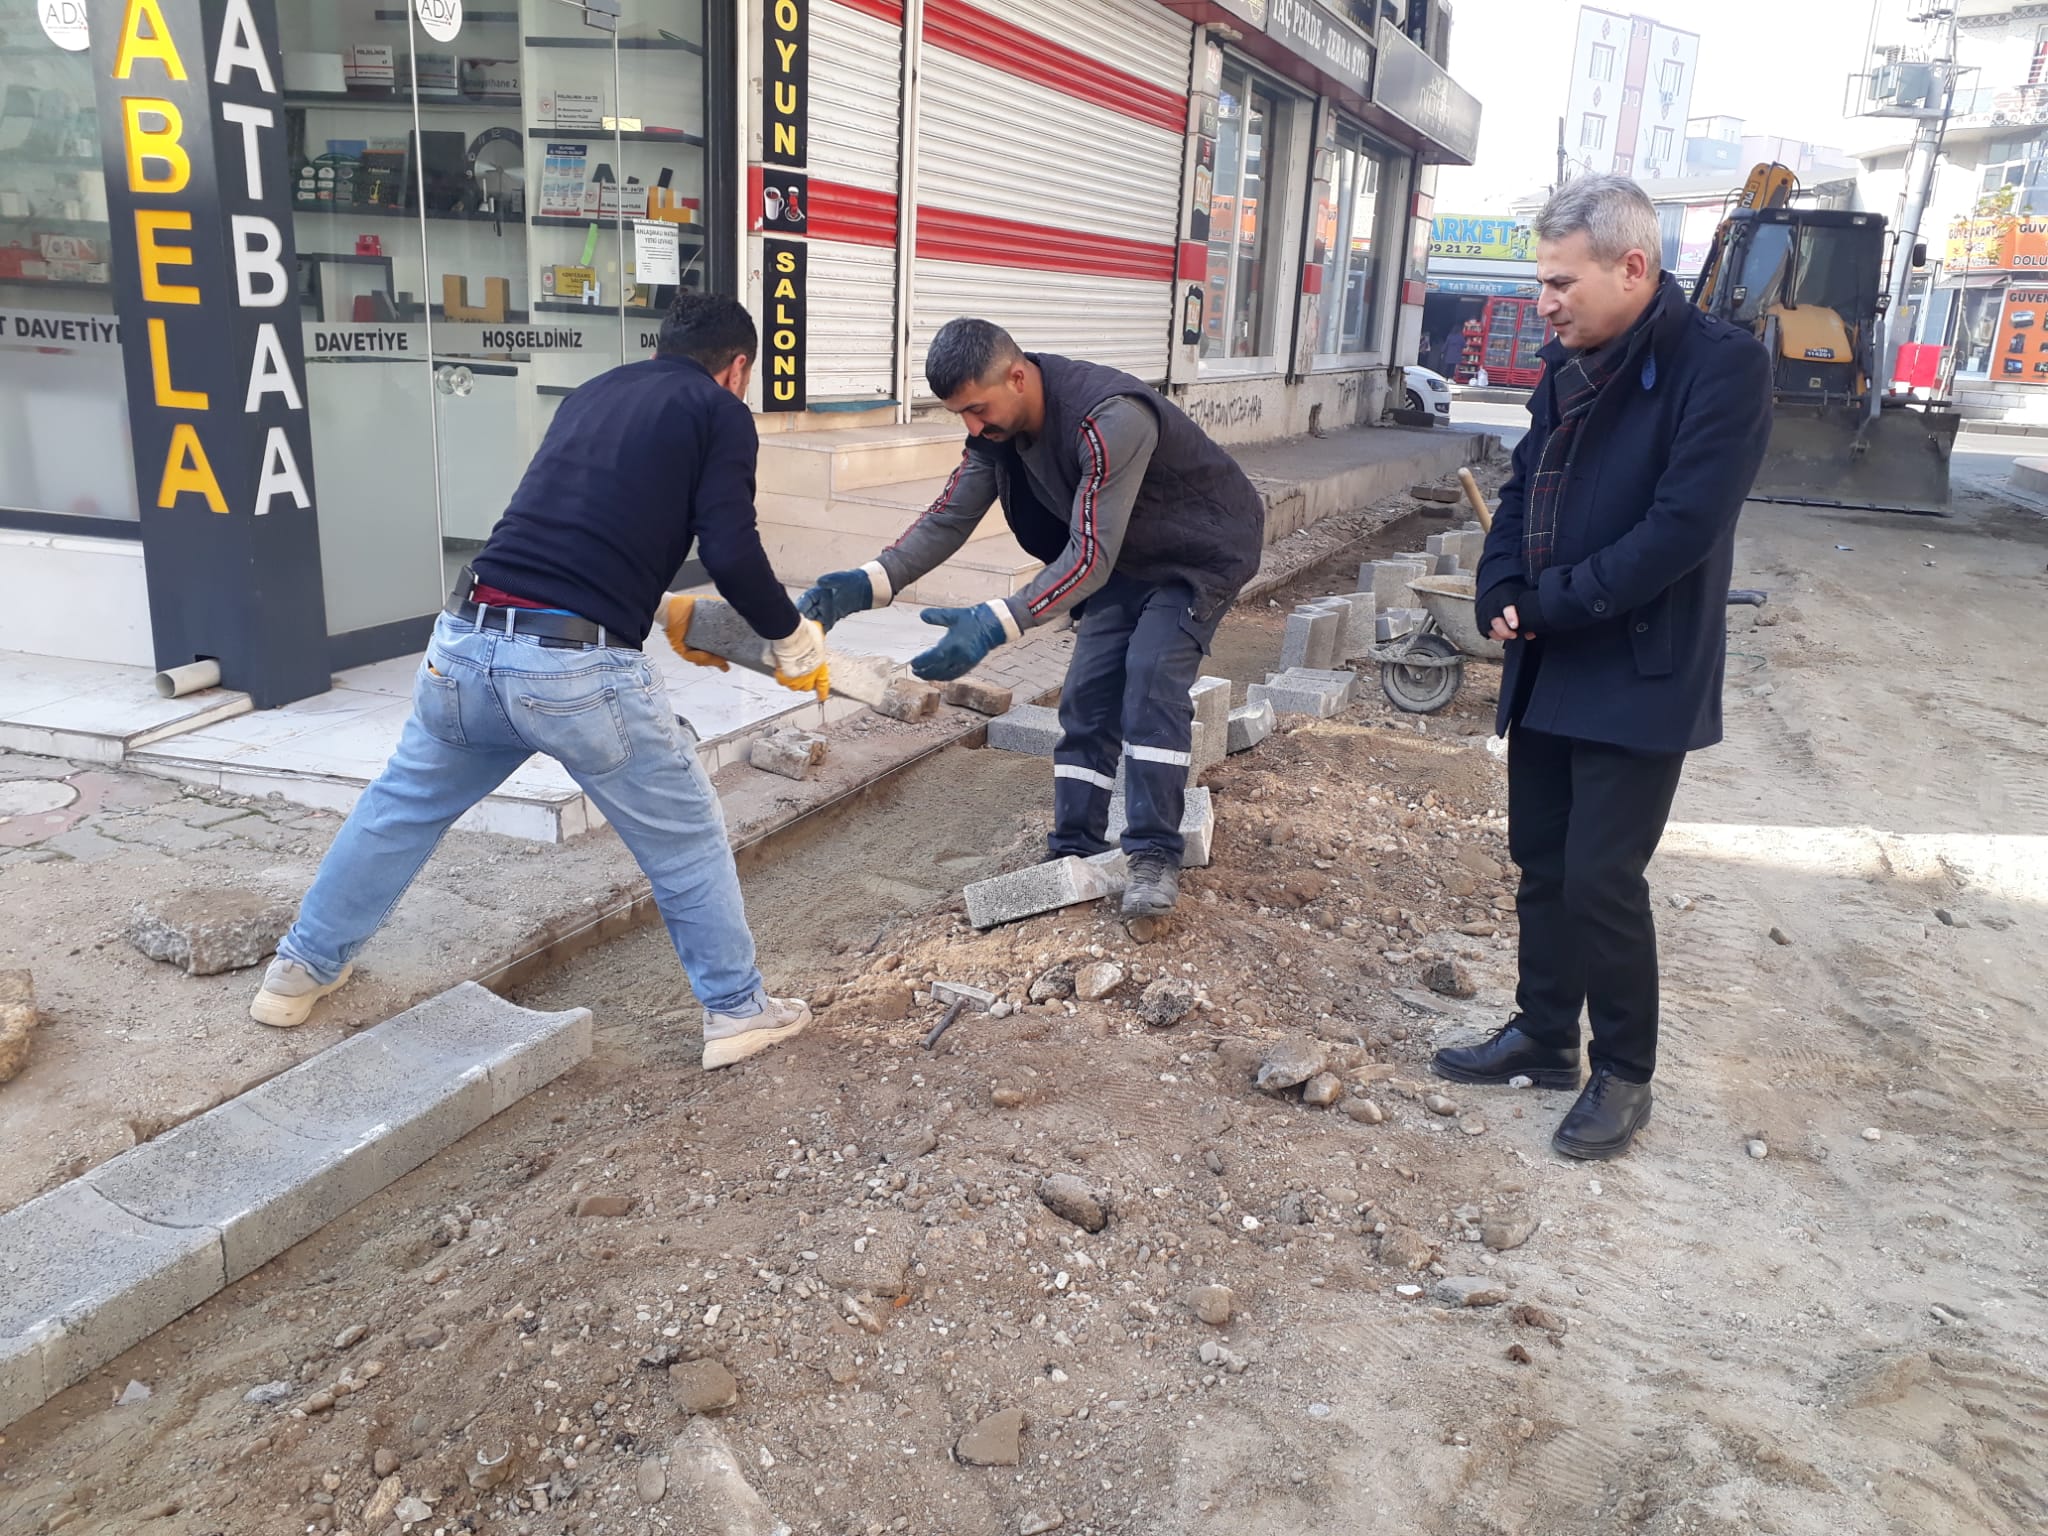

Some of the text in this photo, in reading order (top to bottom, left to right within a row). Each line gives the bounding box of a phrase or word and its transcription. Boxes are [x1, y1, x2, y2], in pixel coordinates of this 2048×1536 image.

[1292, 2, 1322, 50] PERDE
[774, 0, 799, 155] OYUN
[1445, 244, 1462, 253] 21
[1466, 245, 1482, 254] 72
[1448, 283, 1503, 293] TAT MARKET
[773, 251, 797, 400] SALONU
[315, 327, 408, 352] DAVETİYE
[482, 327, 583, 352] HOŞGELDİNİZ
